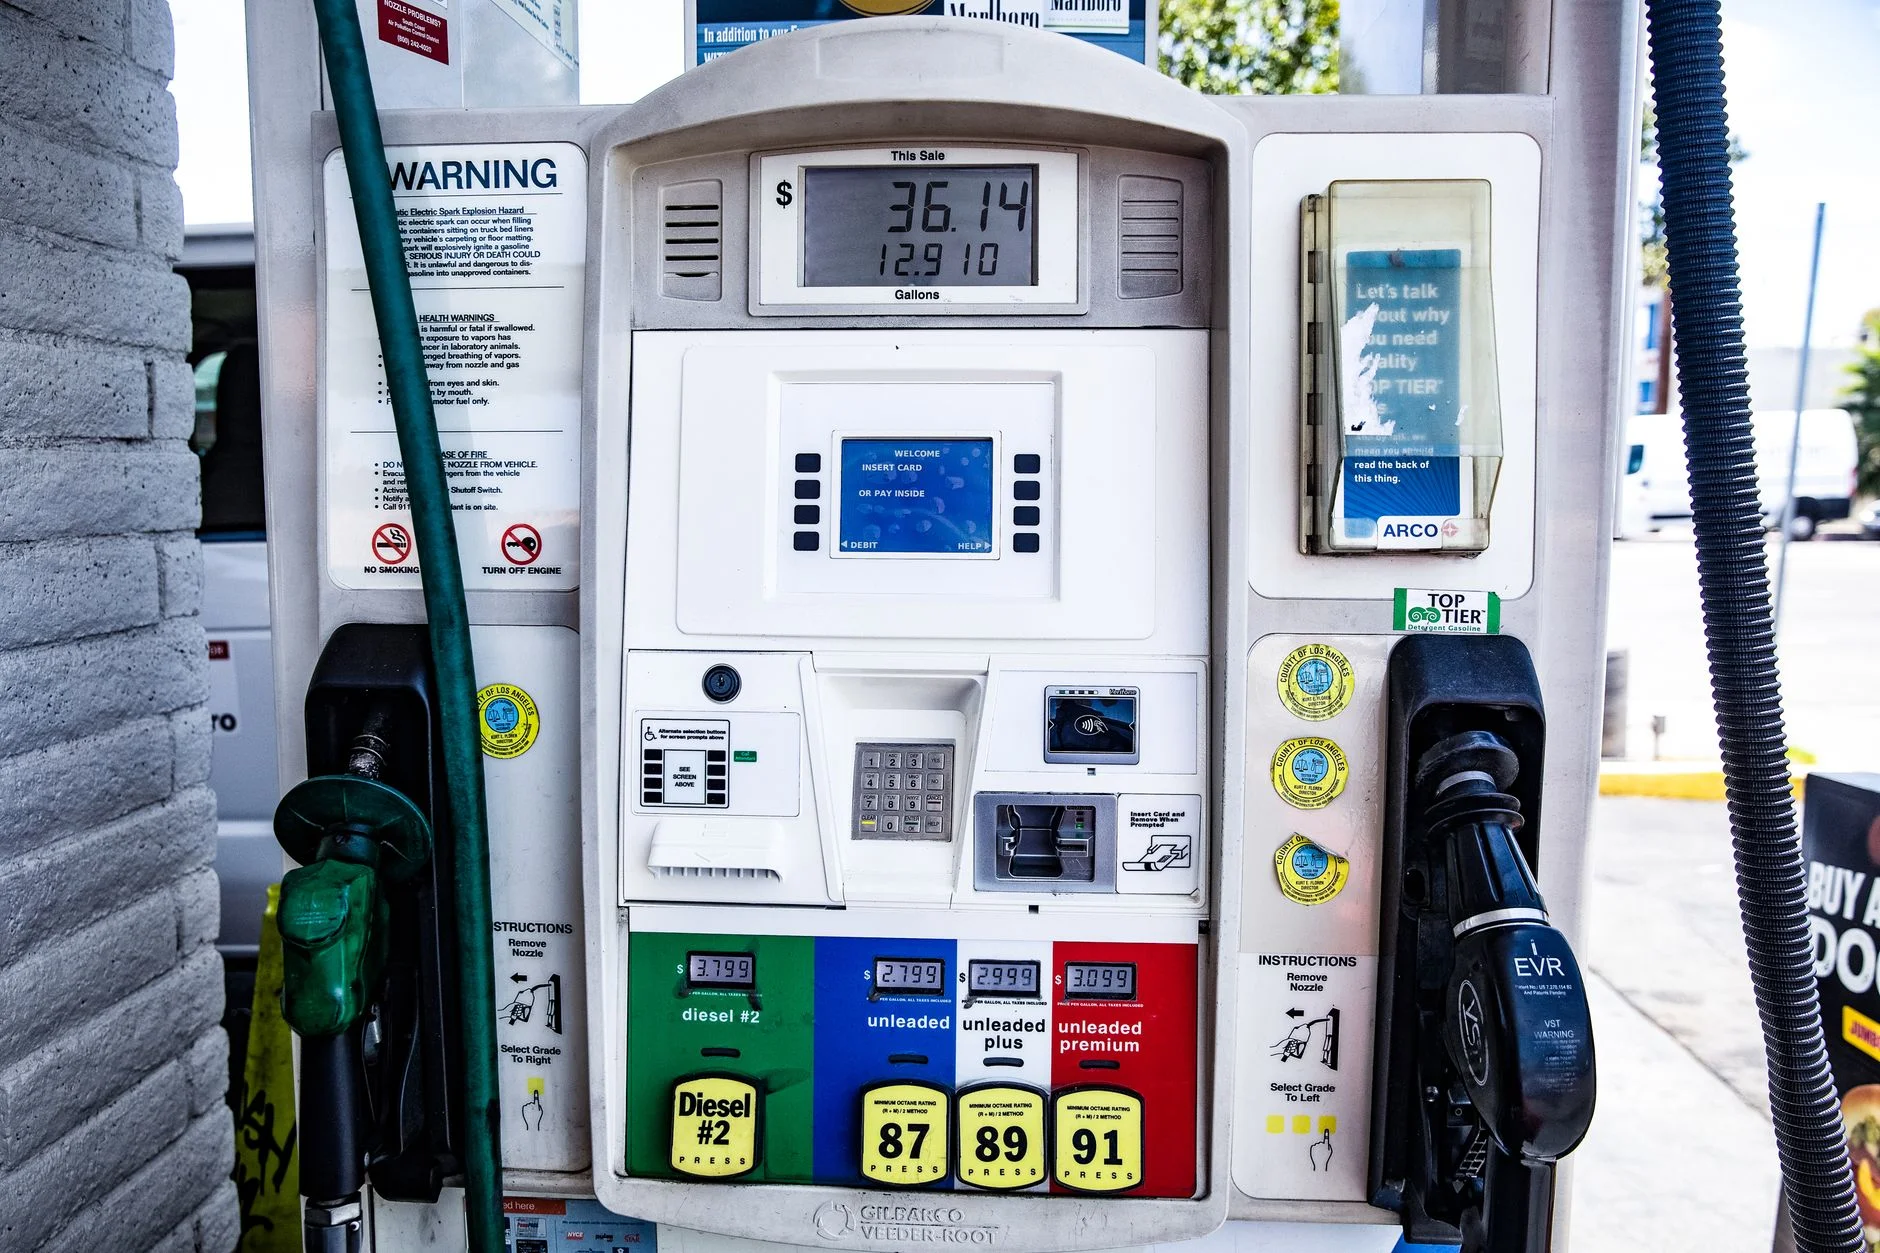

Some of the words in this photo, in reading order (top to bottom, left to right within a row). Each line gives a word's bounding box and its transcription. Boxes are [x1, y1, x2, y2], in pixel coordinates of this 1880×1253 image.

[408, 8, 441, 28] PROBLEMS?
[704, 27, 714, 43] In
[716, 27, 757, 42] addition
[759, 27, 770, 40] to
[891, 150, 918, 161] This
[920, 150, 945, 161] Sale
[386, 158, 557, 191] WARNING
[776, 179, 793, 209] $
[410, 208, 438, 216] Electric
[439, 207, 460, 217] Spark
[462, 206, 497, 216] Explosion
[498, 206, 525, 214] Hazard
[409, 252, 442, 260] SERIOUS
[512, 250, 541, 258] COULD
[895, 290, 940, 300] Gallons
[1356, 283, 1398, 299] Let's
[1403, 283, 1439, 299] talk
[419, 314, 449, 322] HEALTH
[1412, 308, 1450, 325] why
[1392, 330, 1439, 345] need
[458, 451, 469, 459] OF
[470, 450, 488, 459] FIRE
[894, 450, 941, 458] WELCOME
[504, 460, 538, 468] VEHICLE.
[1354, 461, 1376, 469] read
[1378, 461, 1393, 469] the
[1395, 461, 1417, 469] back
[1420, 460, 1430, 469] of
[1354, 474, 1372, 483] this
[1374, 474, 1401, 484] thing.
[895, 490, 925, 498] INSIDE
[1383, 523, 1439, 538] ARCO
[850, 541, 878, 549] DEBIT
[958, 542, 982, 550] HELP
[364, 566, 377, 574] NO
[379, 566, 420, 574] SMOKING
[482, 566, 506, 574] TURN
[528, 567, 562, 575] ENGINE
[1427, 593, 1465, 608] TOP
[1407, 624, 1446, 632] Detergent
[1448, 624, 1481, 632] Gasoline
[1280, 655, 1298, 683] COUNTY
[1298, 648, 1308, 658] OF
[1309, 647, 1325, 655] LOS
[1325, 650, 1350, 677] ANGELES
[485, 688, 495, 697] OF
[496, 686, 510, 695] LOS
[511, 690, 535, 716] ANGELES
[1276, 742, 1296, 767] COUNTY
[1325, 743, 1346, 771] ANGELES
[890, 758, 896, 767] 2
[911, 758, 917, 767] 3
[867, 779, 873, 787] 4
[889, 779, 895, 787] 5
[911, 779, 916, 788] 6
[866, 800, 872, 808] 7
[888, 800, 894, 809] 8
[910, 800, 915, 809] 9
[887, 821, 893, 830] 0
[1807, 861, 1866, 920] BUY
[493, 922, 573, 934] STRUCTIONS
[508, 939, 547, 948] Remove
[512, 949, 543, 958] Nozzle
[1258, 955, 1357, 967] INSTRUCTIONS
[1514, 957, 1565, 976] EVR
[677, 964, 684, 974] $
[696, 959, 749, 978] 3.799
[882, 964, 937, 983] 2.799
[863, 969, 871, 980] $
[959, 972, 966, 983] $
[977, 967, 1032, 986] 2.999
[1073, 968, 1127, 988] 3.099
[1286, 973, 1328, 982] Remove
[1055, 975, 1062, 986] $
[1290, 982, 1324, 992] Nozzle
[682, 1008, 734, 1023] diesel
[740, 1010, 760, 1023] #2
[867, 1014, 950, 1029] unleaded
[963, 1018, 1045, 1032] unleaded
[1544, 1019, 1561, 1028] VST
[1058, 1020, 1142, 1035] unleaded
[1533, 1030, 1575, 1039] WARNING
[985, 1035, 1023, 1051] plus
[1060, 1038, 1140, 1053] premium
[501, 1044, 530, 1054] Select
[532, 1046, 561, 1055] Grade
[511, 1055, 523, 1063] To
[525, 1055, 551, 1065] Right
[1270, 1083, 1302, 1093] Select
[1304, 1084, 1336, 1093] Grade
[1285, 1093, 1298, 1102] To
[1300, 1093, 1320, 1102] Left
[679, 1092, 751, 1118] Diesel
[697, 1119, 730, 1145] #2
[878, 1122, 930, 1159] 87
[975, 1126, 1027, 1162] 89
[1072, 1128, 1123, 1165] 91
[860, 1204, 965, 1224] GILBARCO
[860, 1225, 997, 1244] VEEDER-ROOT
